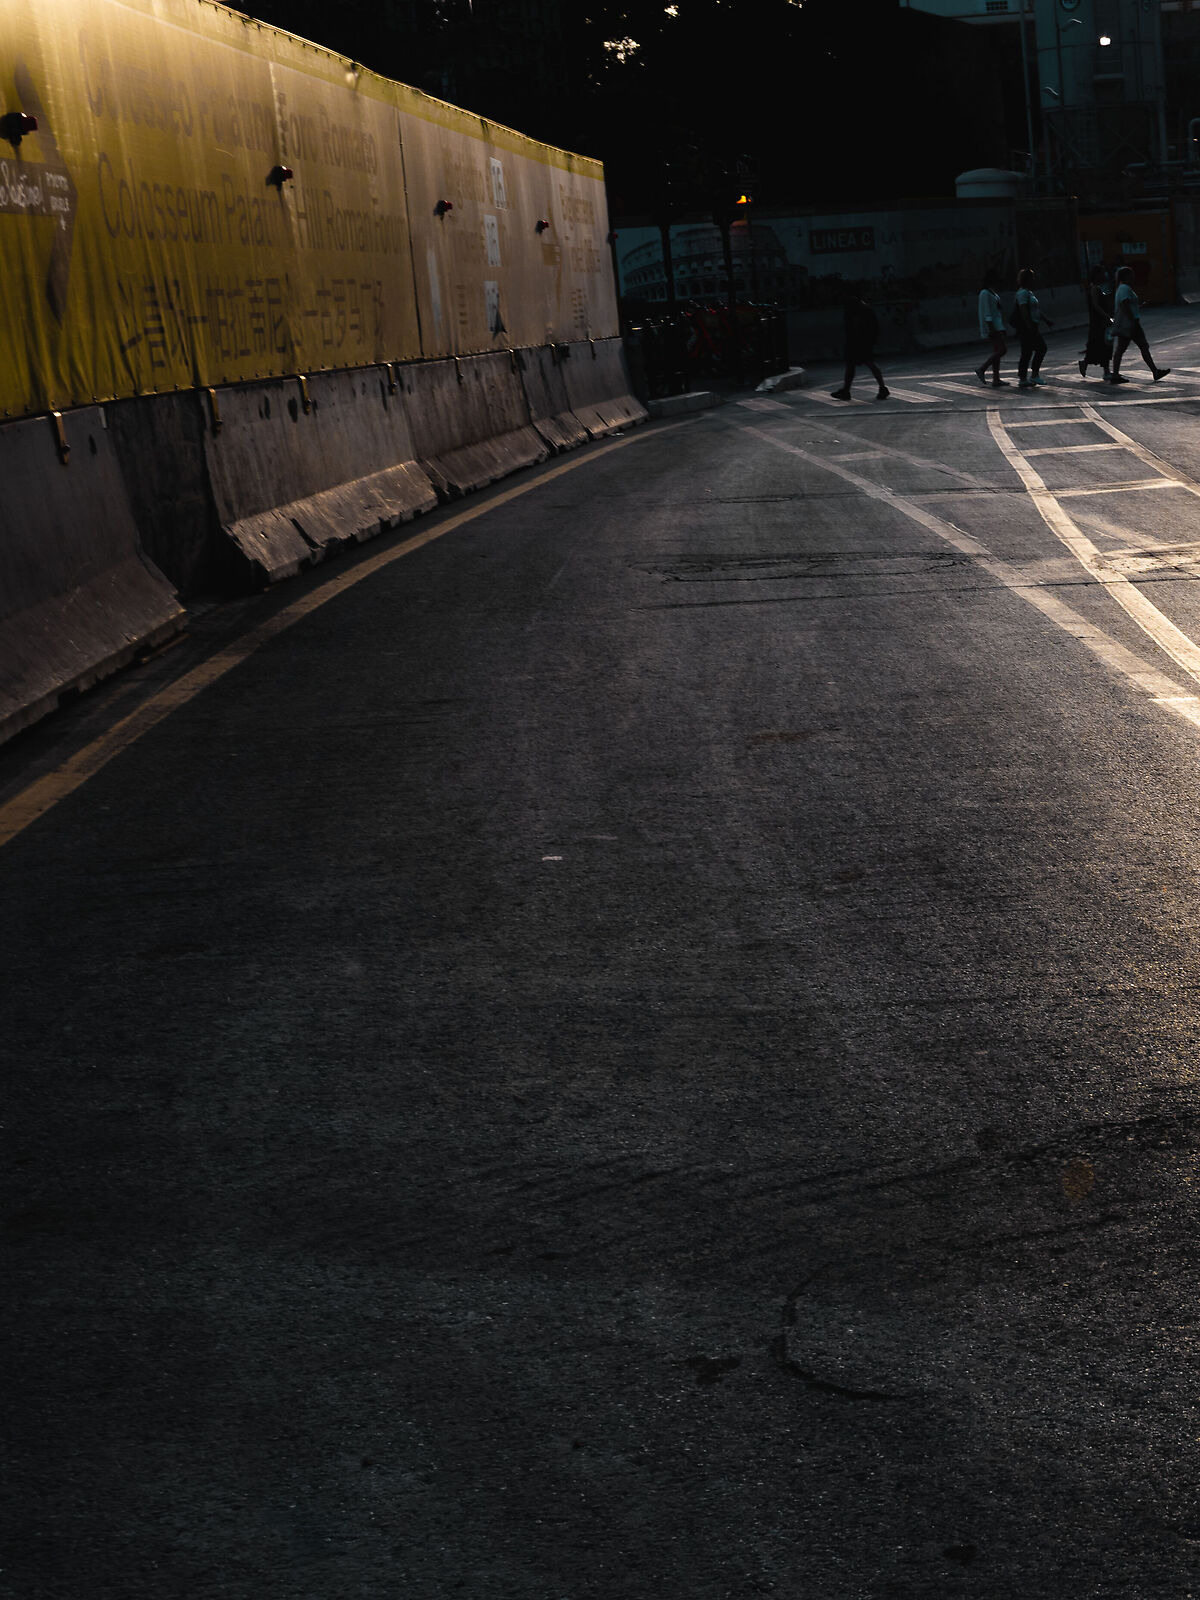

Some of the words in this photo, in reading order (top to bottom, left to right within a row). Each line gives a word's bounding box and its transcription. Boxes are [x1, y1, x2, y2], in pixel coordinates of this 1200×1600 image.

[98, 151, 223, 245] Colosseum
[293, 186, 323, 250] Hill
[324, 189, 371, 252] Roman
[812, 231, 857, 250] LINEA
[862, 231, 872, 246] C
